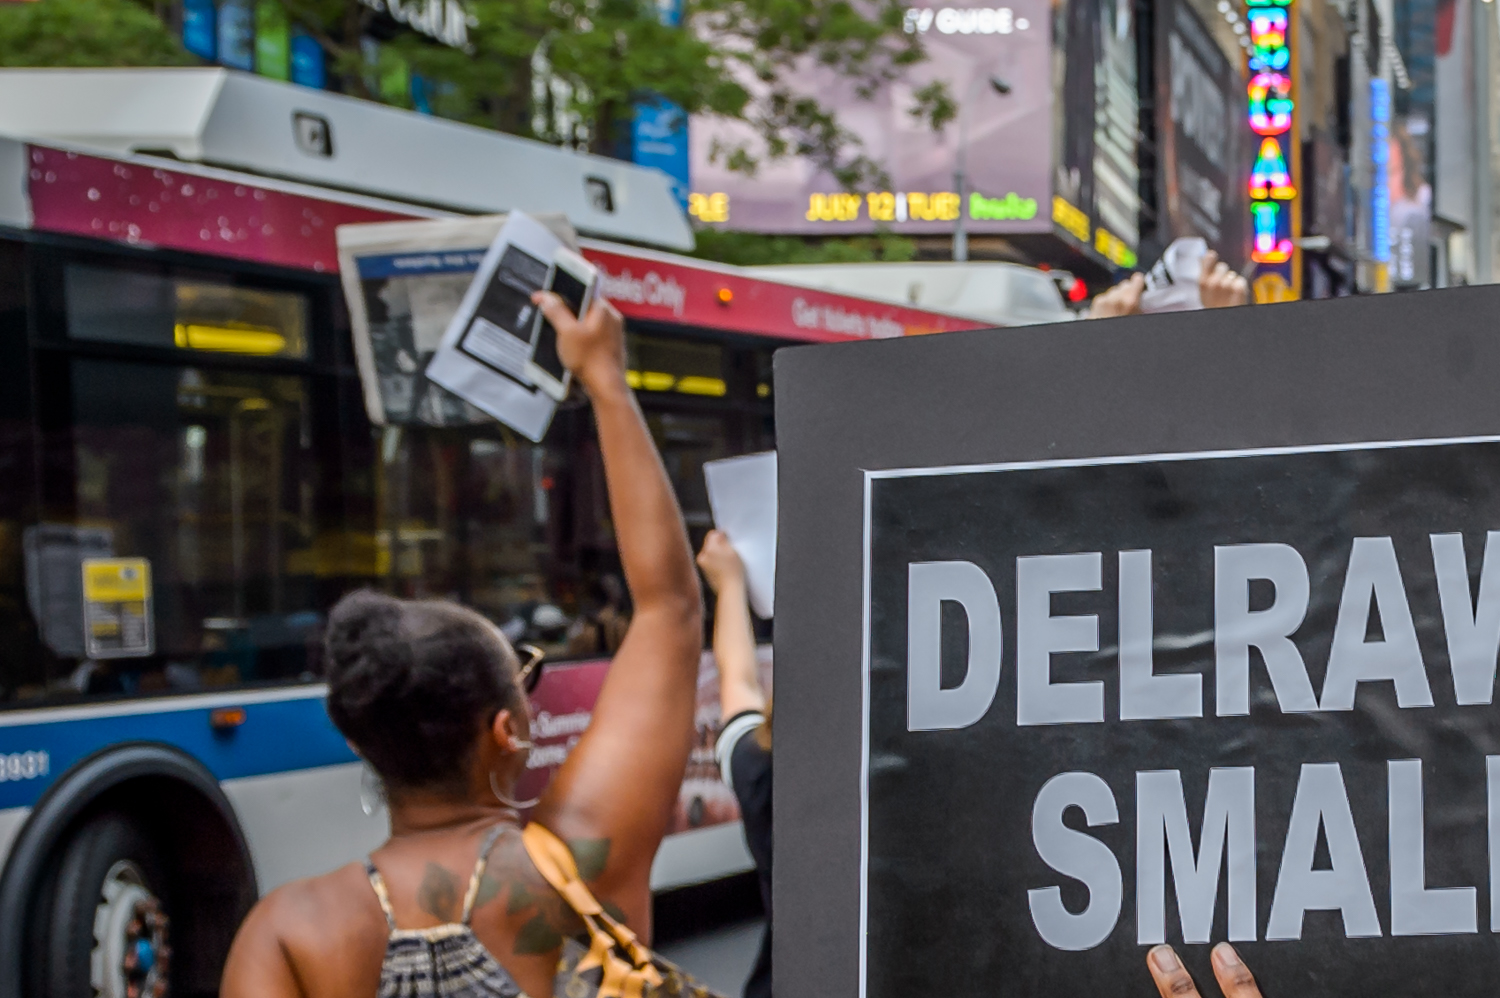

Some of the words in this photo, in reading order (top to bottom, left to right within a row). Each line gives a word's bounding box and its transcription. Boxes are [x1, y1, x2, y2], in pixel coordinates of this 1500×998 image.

[935, 7, 1013, 35] GUIDE
[1247, 0, 1297, 263] EGAL
[806, 192, 861, 221] JULY
